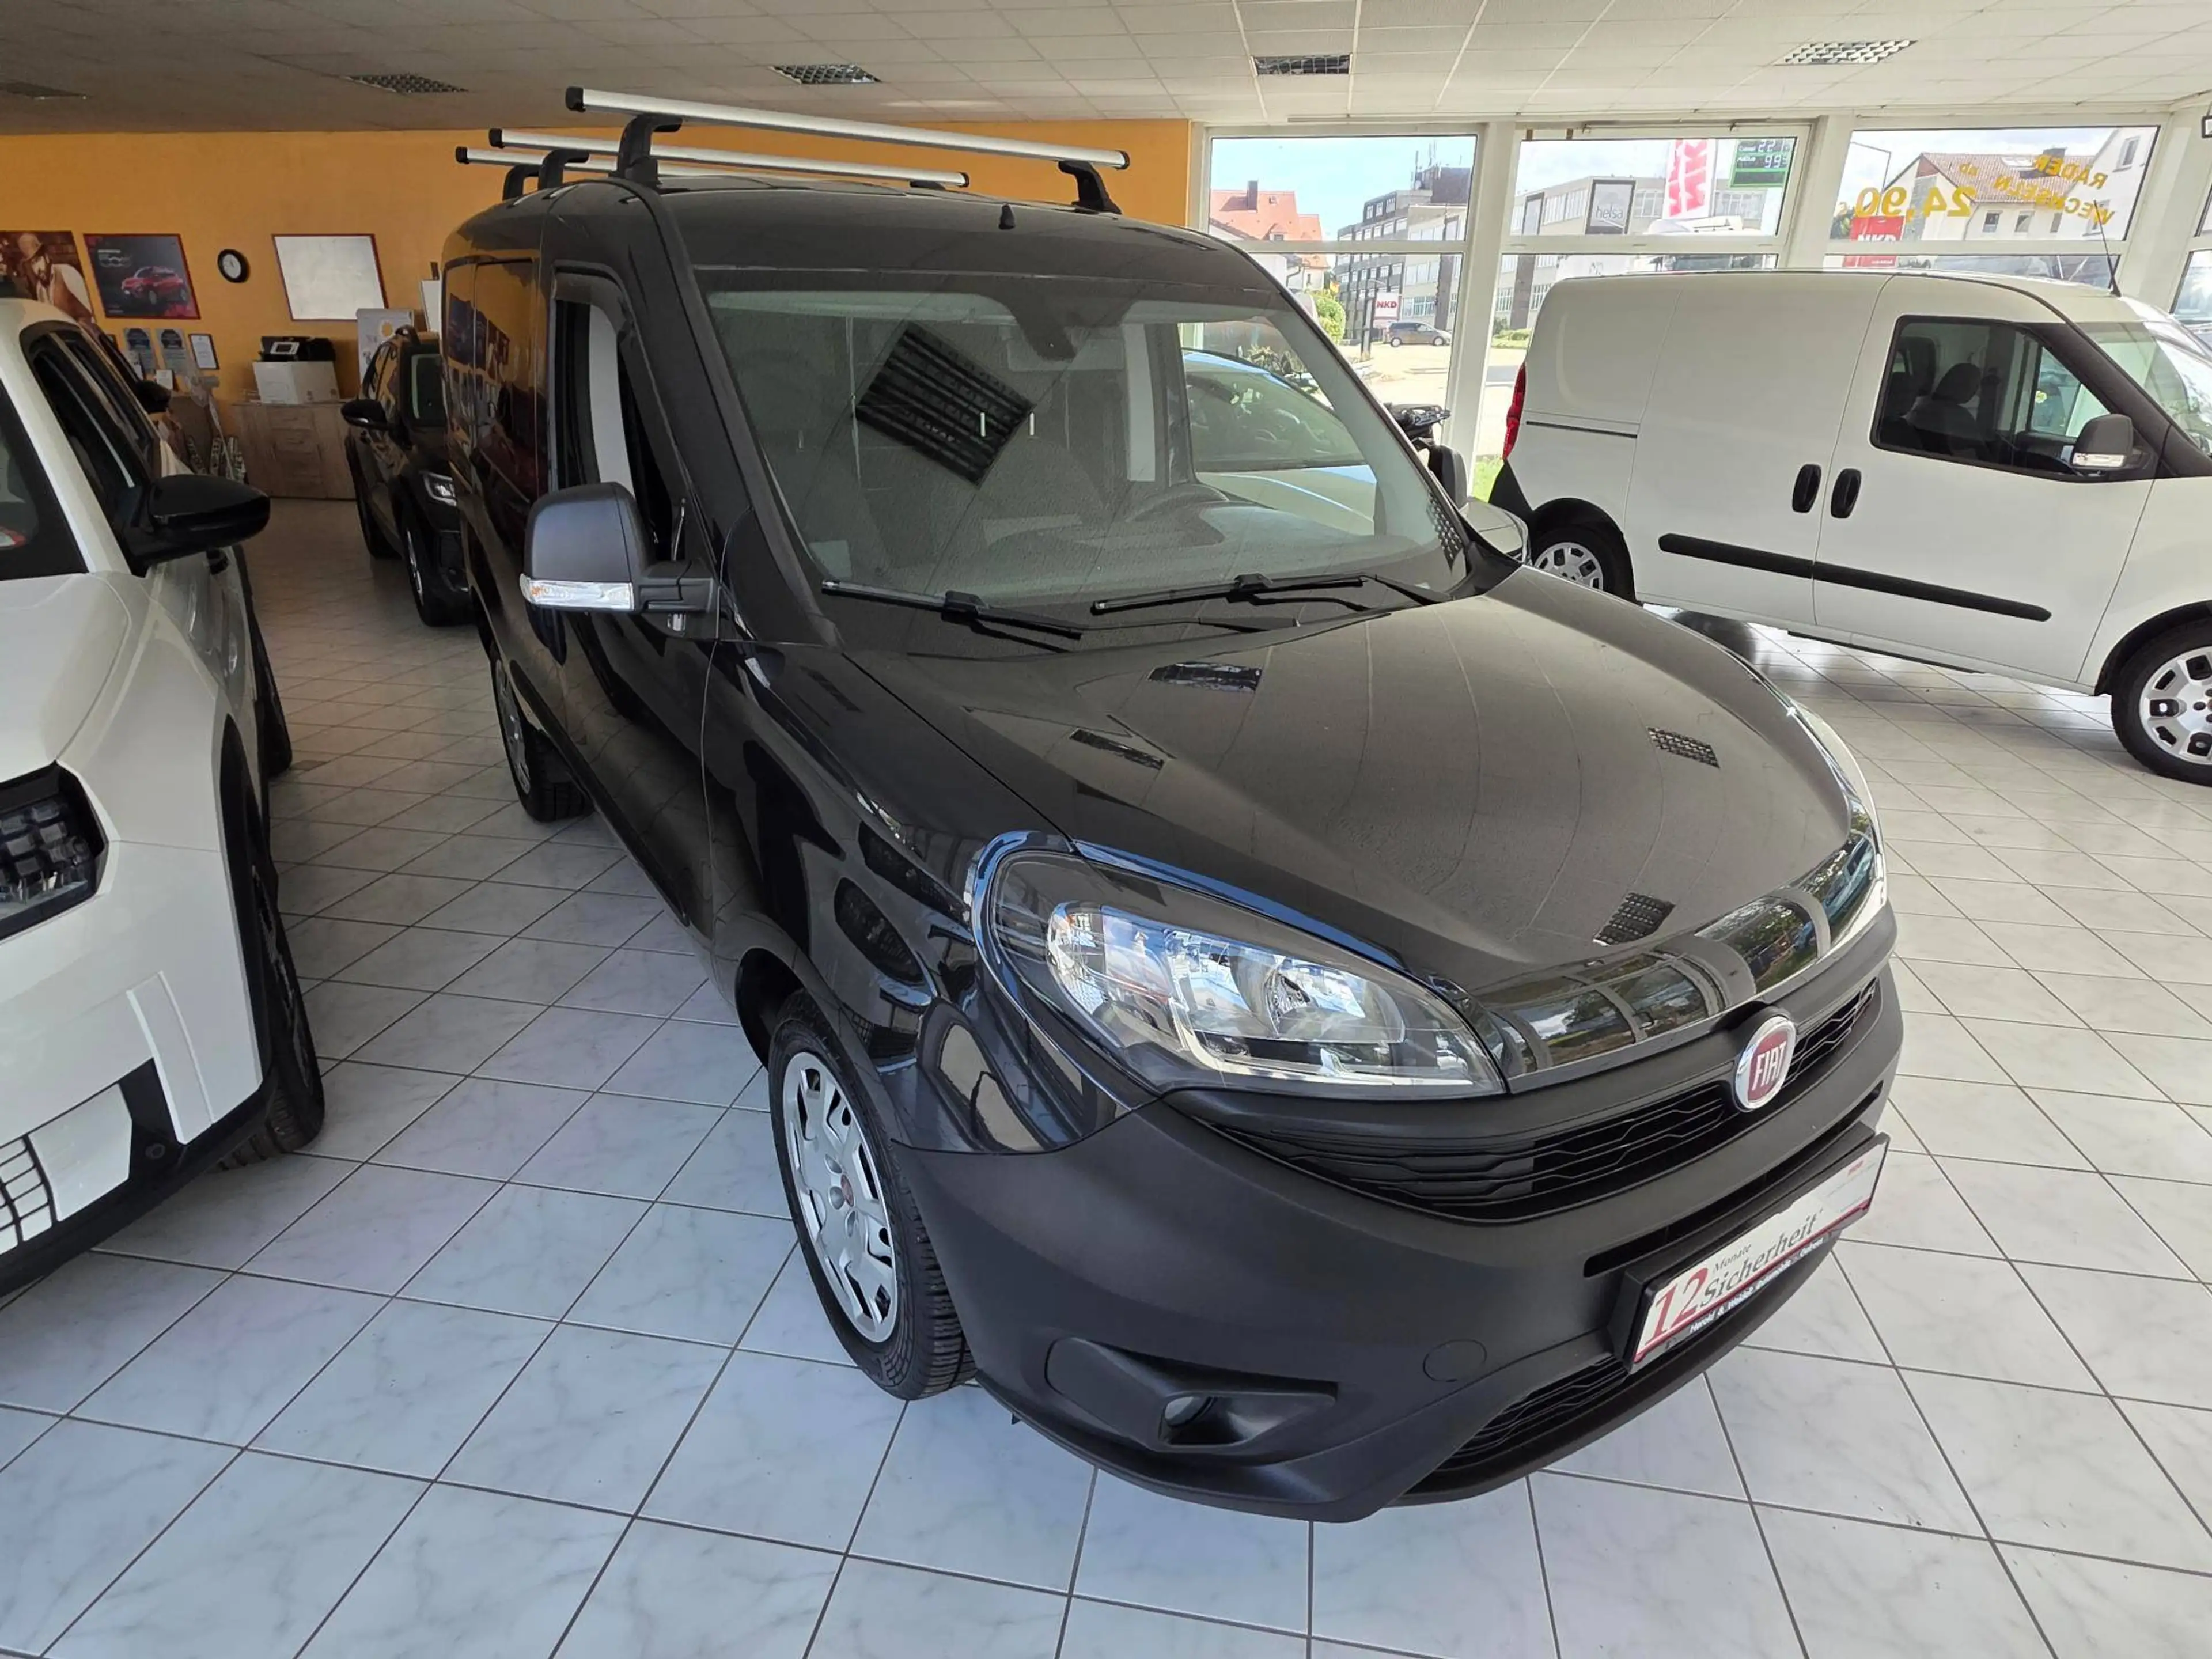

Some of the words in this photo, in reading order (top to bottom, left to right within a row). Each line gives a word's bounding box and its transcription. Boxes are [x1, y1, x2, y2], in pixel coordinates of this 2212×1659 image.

[1596, 202, 1623, 219] helsa
[1377, 300, 1397, 308] NKD
[1752, 1041, 1787, 1090] FIAT
[1713, 1244, 1751, 1272] Monate
[1645, 1267, 1709, 1345] 12
